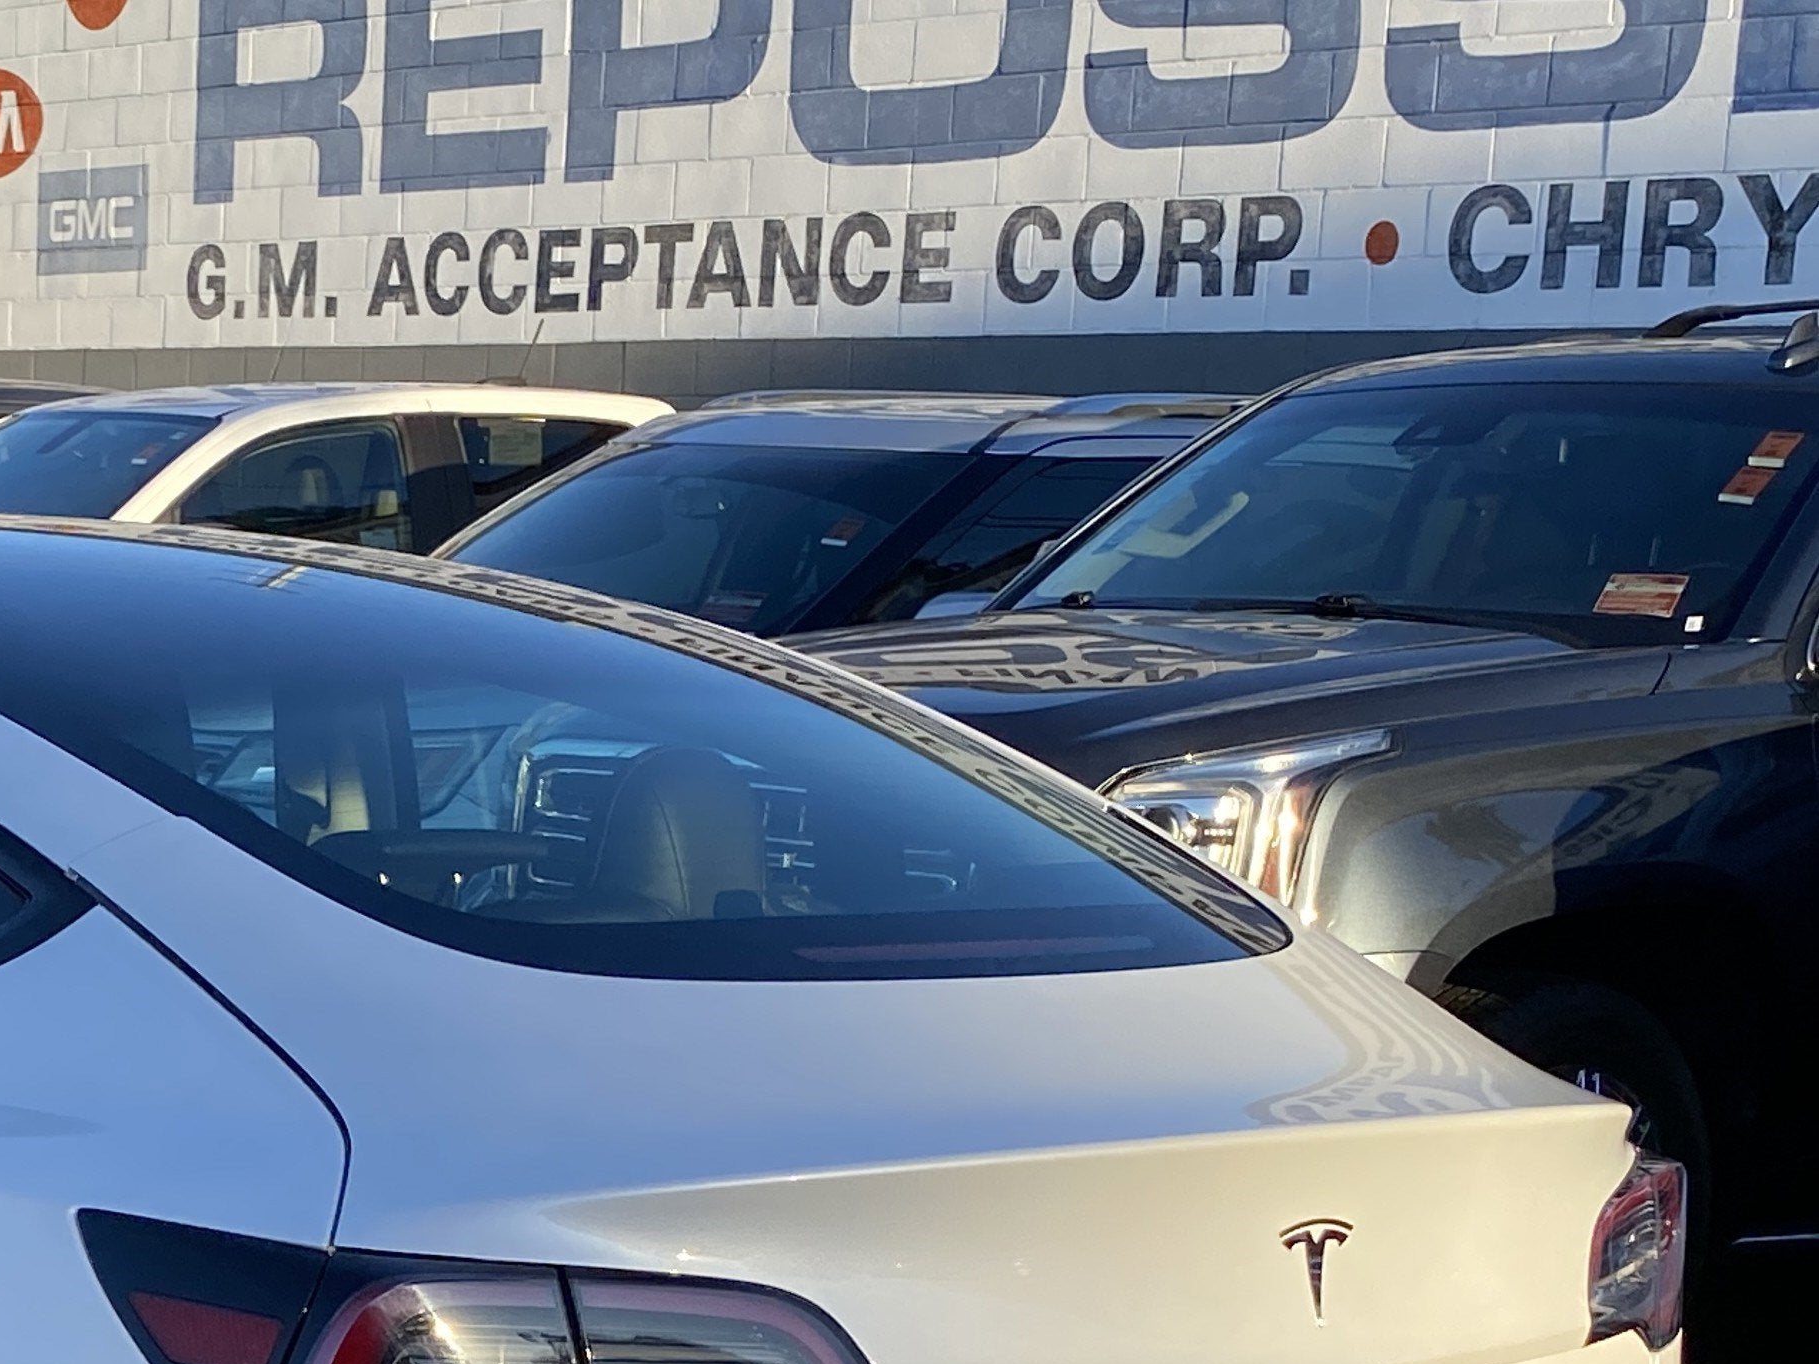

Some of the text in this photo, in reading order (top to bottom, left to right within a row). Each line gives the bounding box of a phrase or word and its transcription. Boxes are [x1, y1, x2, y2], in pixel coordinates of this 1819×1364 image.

[49, 197, 135, 243] GMC
[186, 172, 1819, 320] G.M. ACCEPTANCE CORP. CHRY
